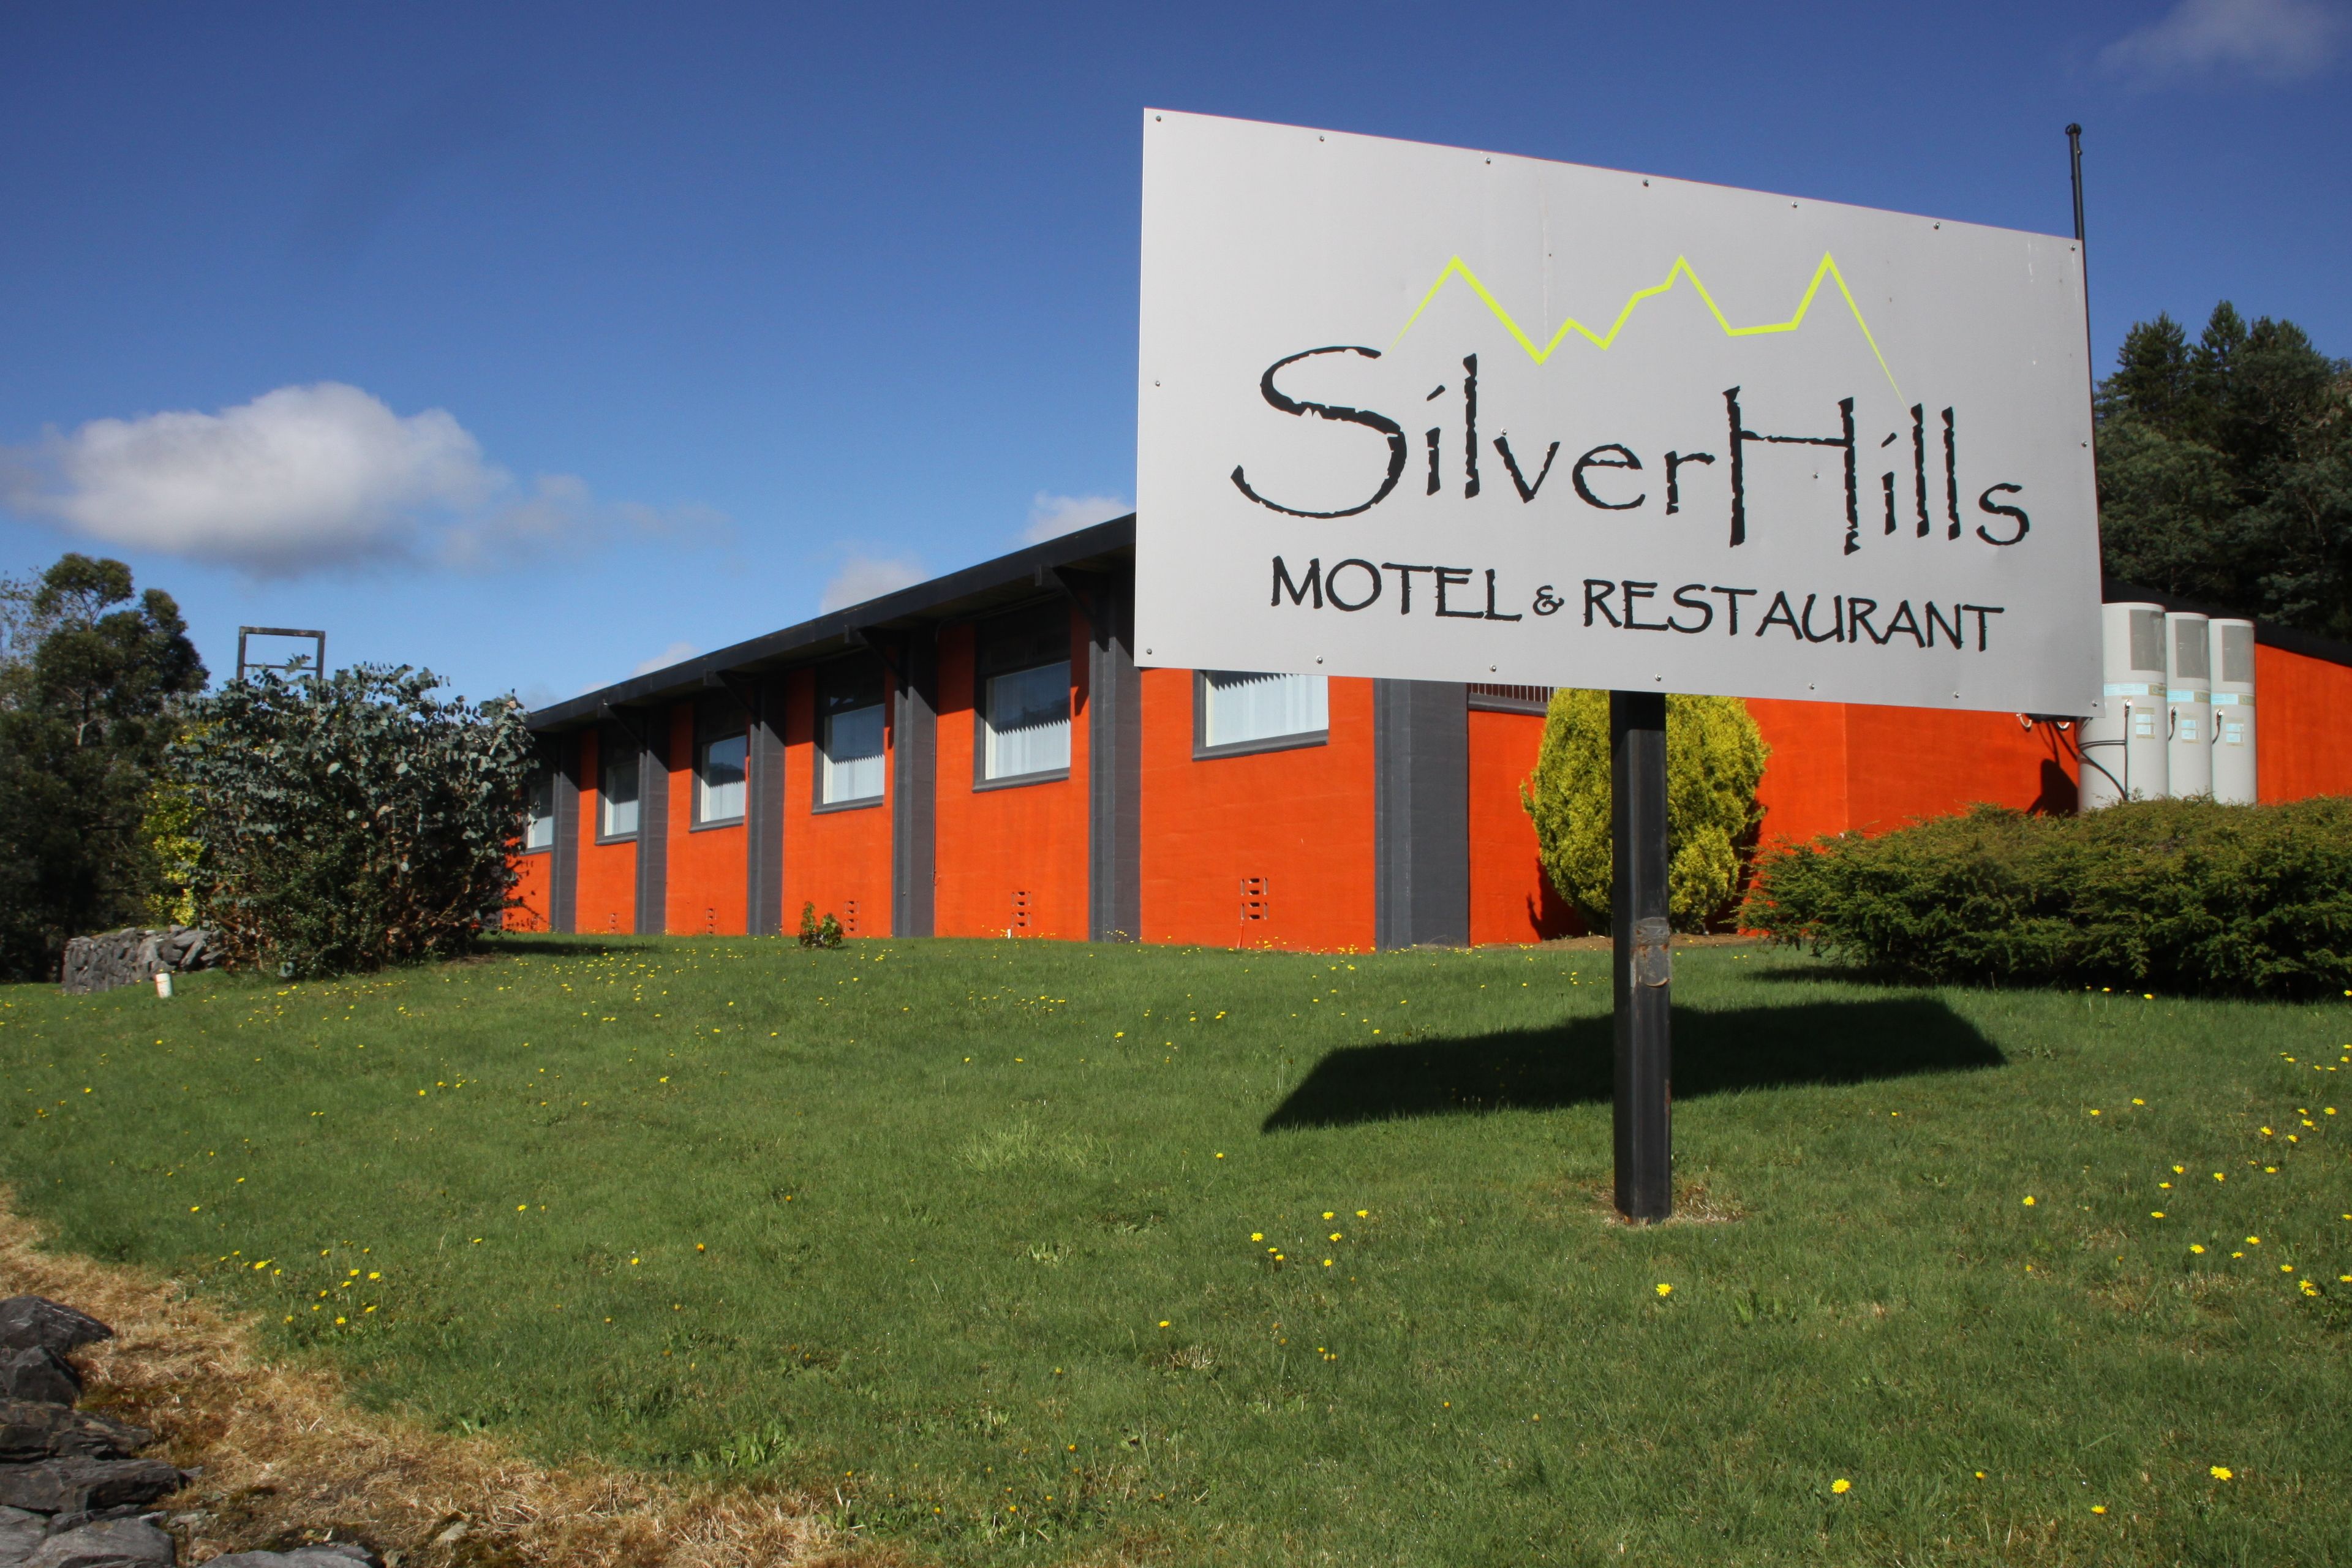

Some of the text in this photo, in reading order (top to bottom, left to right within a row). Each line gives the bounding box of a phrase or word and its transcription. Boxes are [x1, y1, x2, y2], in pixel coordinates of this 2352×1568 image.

[1272, 556, 2005, 652] MOTEL & RESTAURANT
